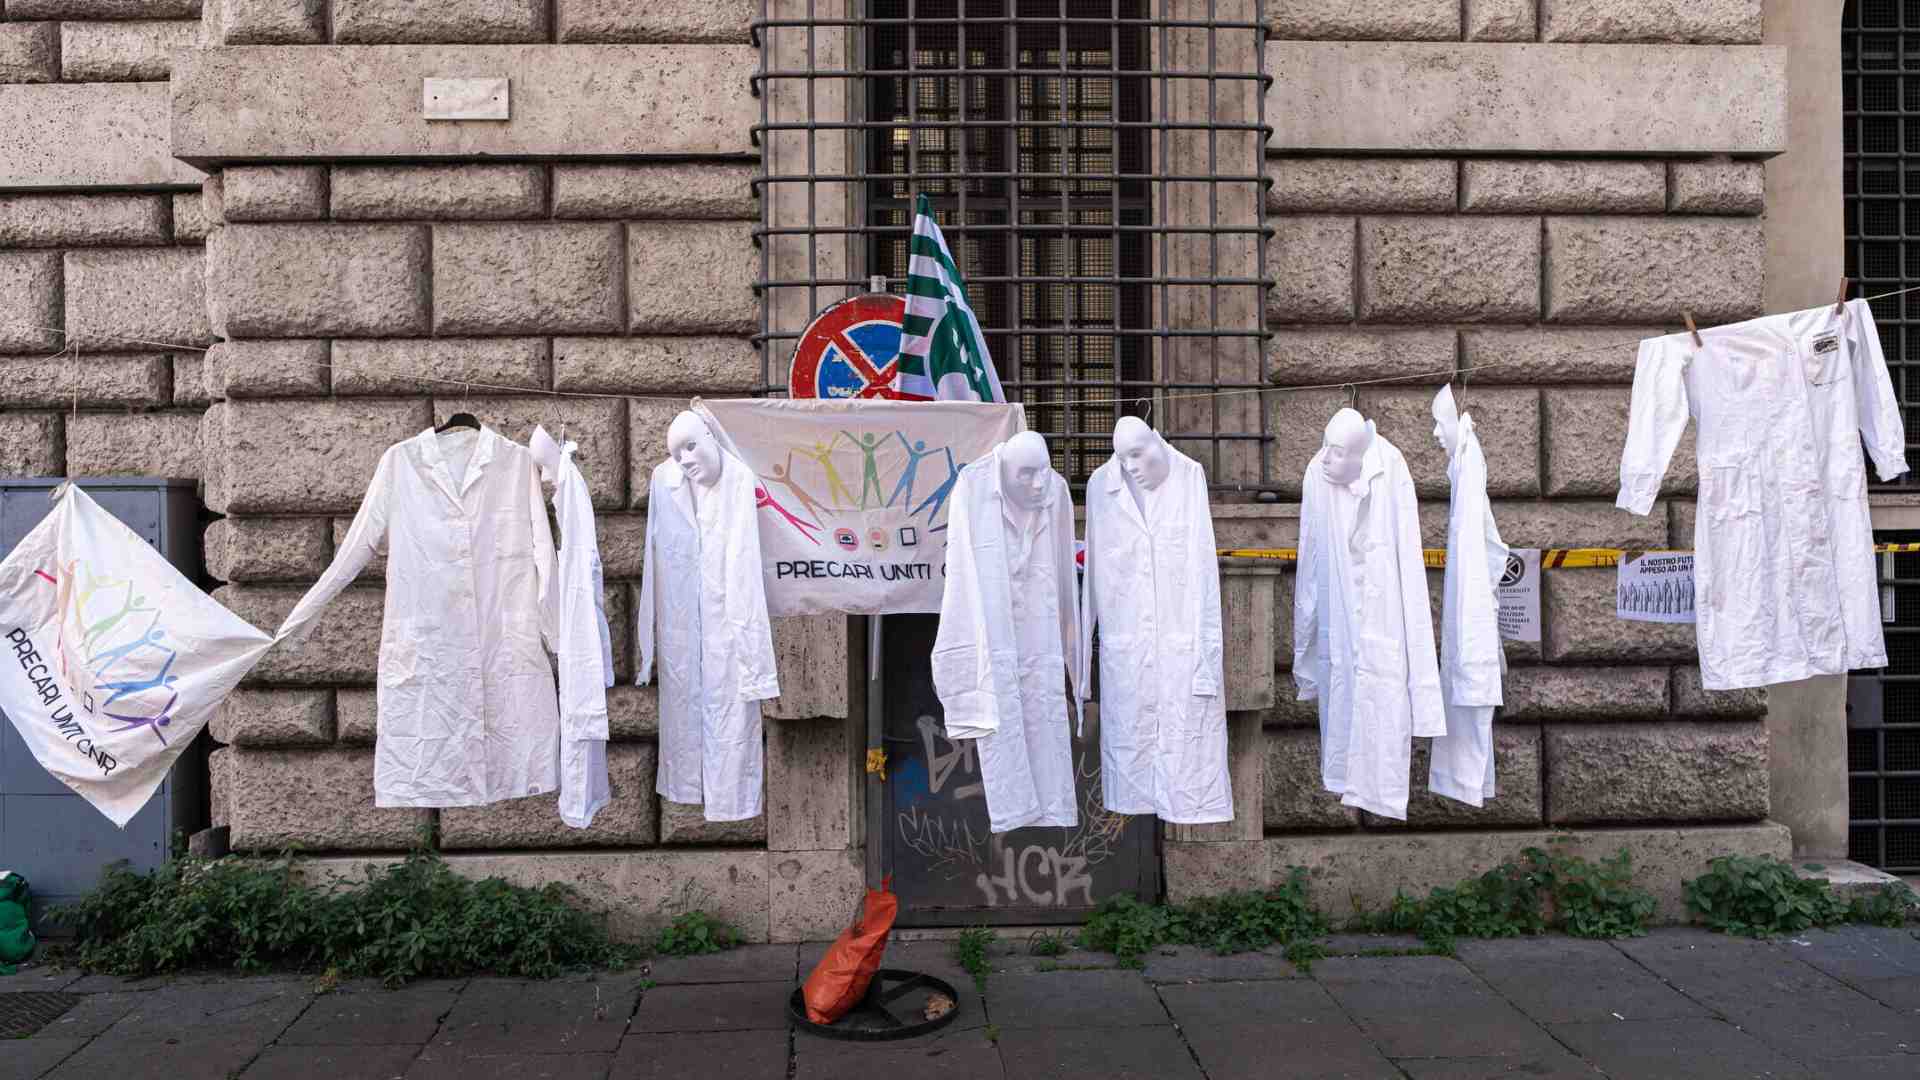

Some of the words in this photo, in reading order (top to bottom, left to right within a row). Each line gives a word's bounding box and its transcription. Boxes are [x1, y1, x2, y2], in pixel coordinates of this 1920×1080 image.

[1648, 557, 1676, 566] NOSTRO
[776, 560, 874, 580] PRECARI
[880, 563, 931, 581] UNITI
[1640, 566, 1666, 574] APPESO
[5, 627, 62, 706] PRECARI
[76, 738, 117, 776] CNR
